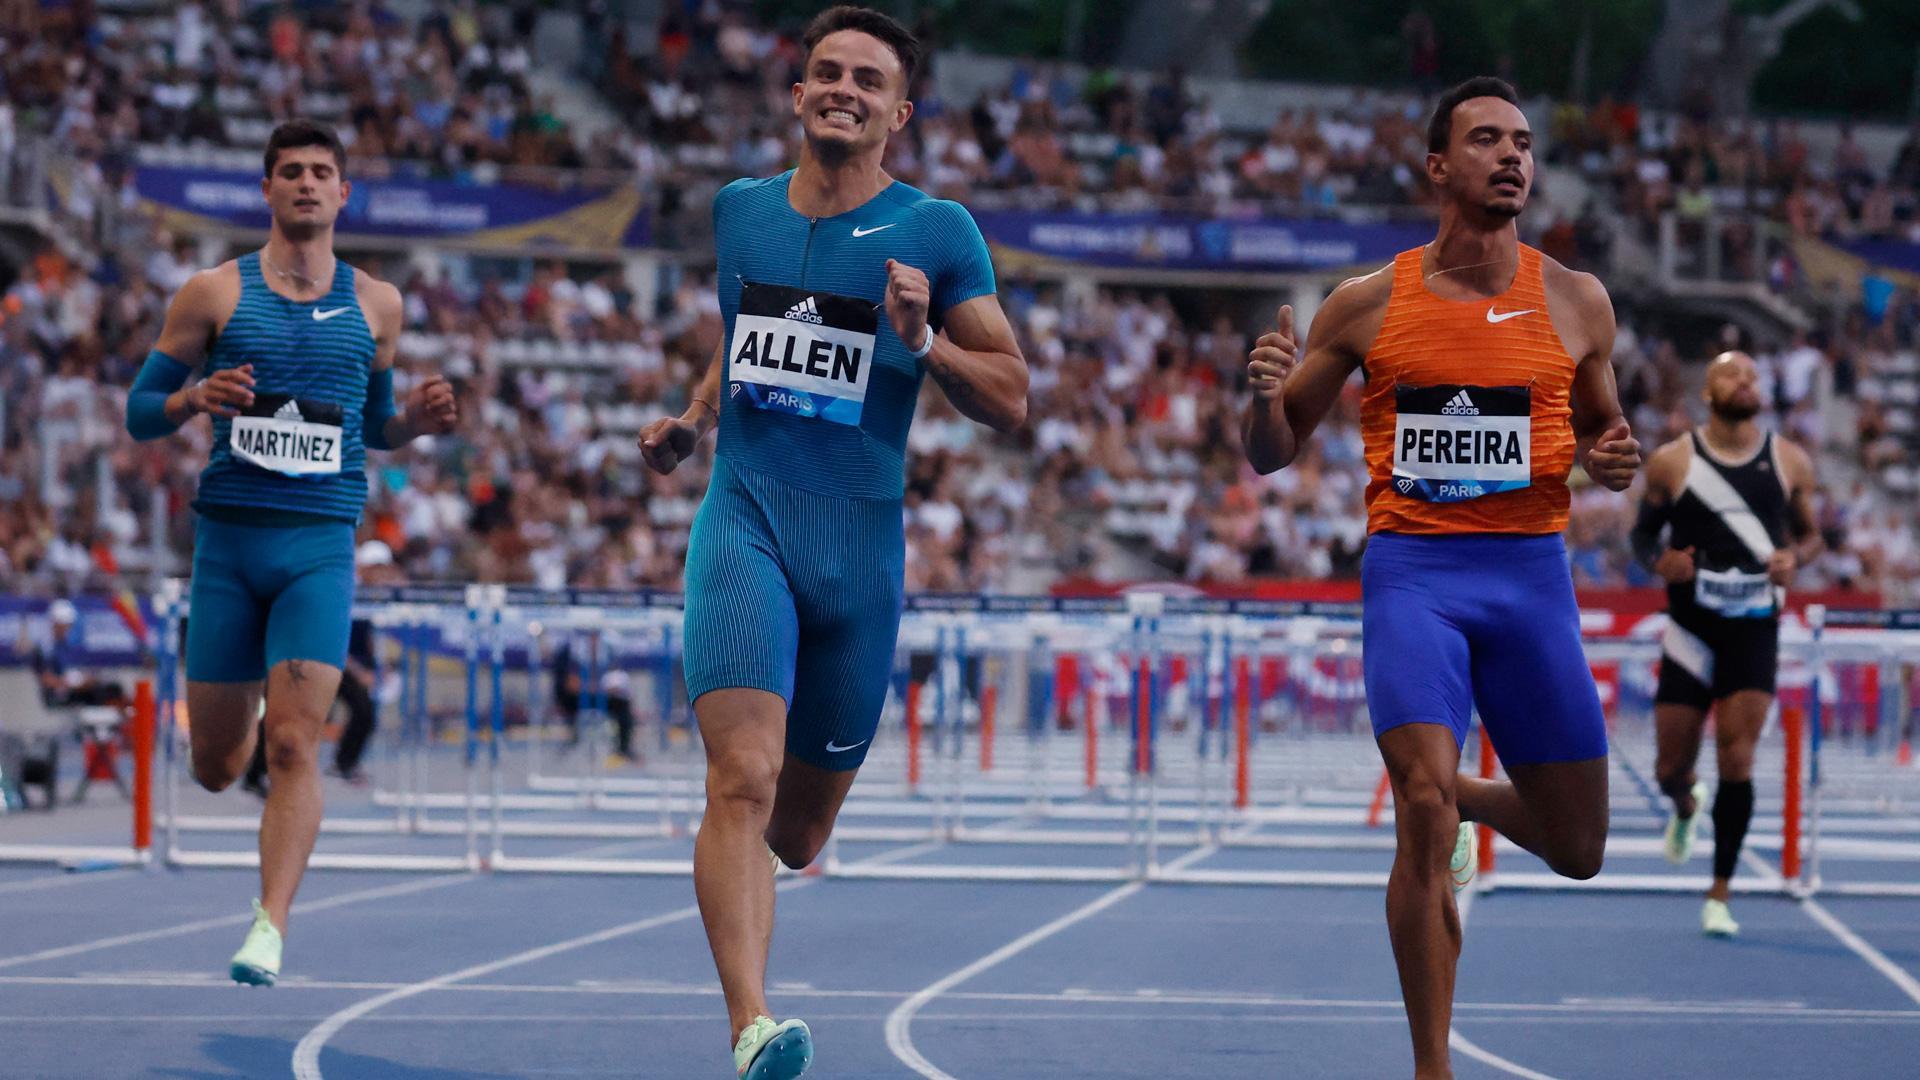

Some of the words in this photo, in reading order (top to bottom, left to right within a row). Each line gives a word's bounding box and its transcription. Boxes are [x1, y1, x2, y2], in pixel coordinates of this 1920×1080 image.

[784, 310, 823, 325] adidas
[735, 330, 862, 384] ALLEN
[767, 391, 814, 411] PARIS
[1441, 405, 1480, 416] adidas
[238, 426, 334, 462] MARTÍNEZ
[1401, 428, 1523, 465] PEREIRA
[1439, 485, 1483, 497] PARIS
